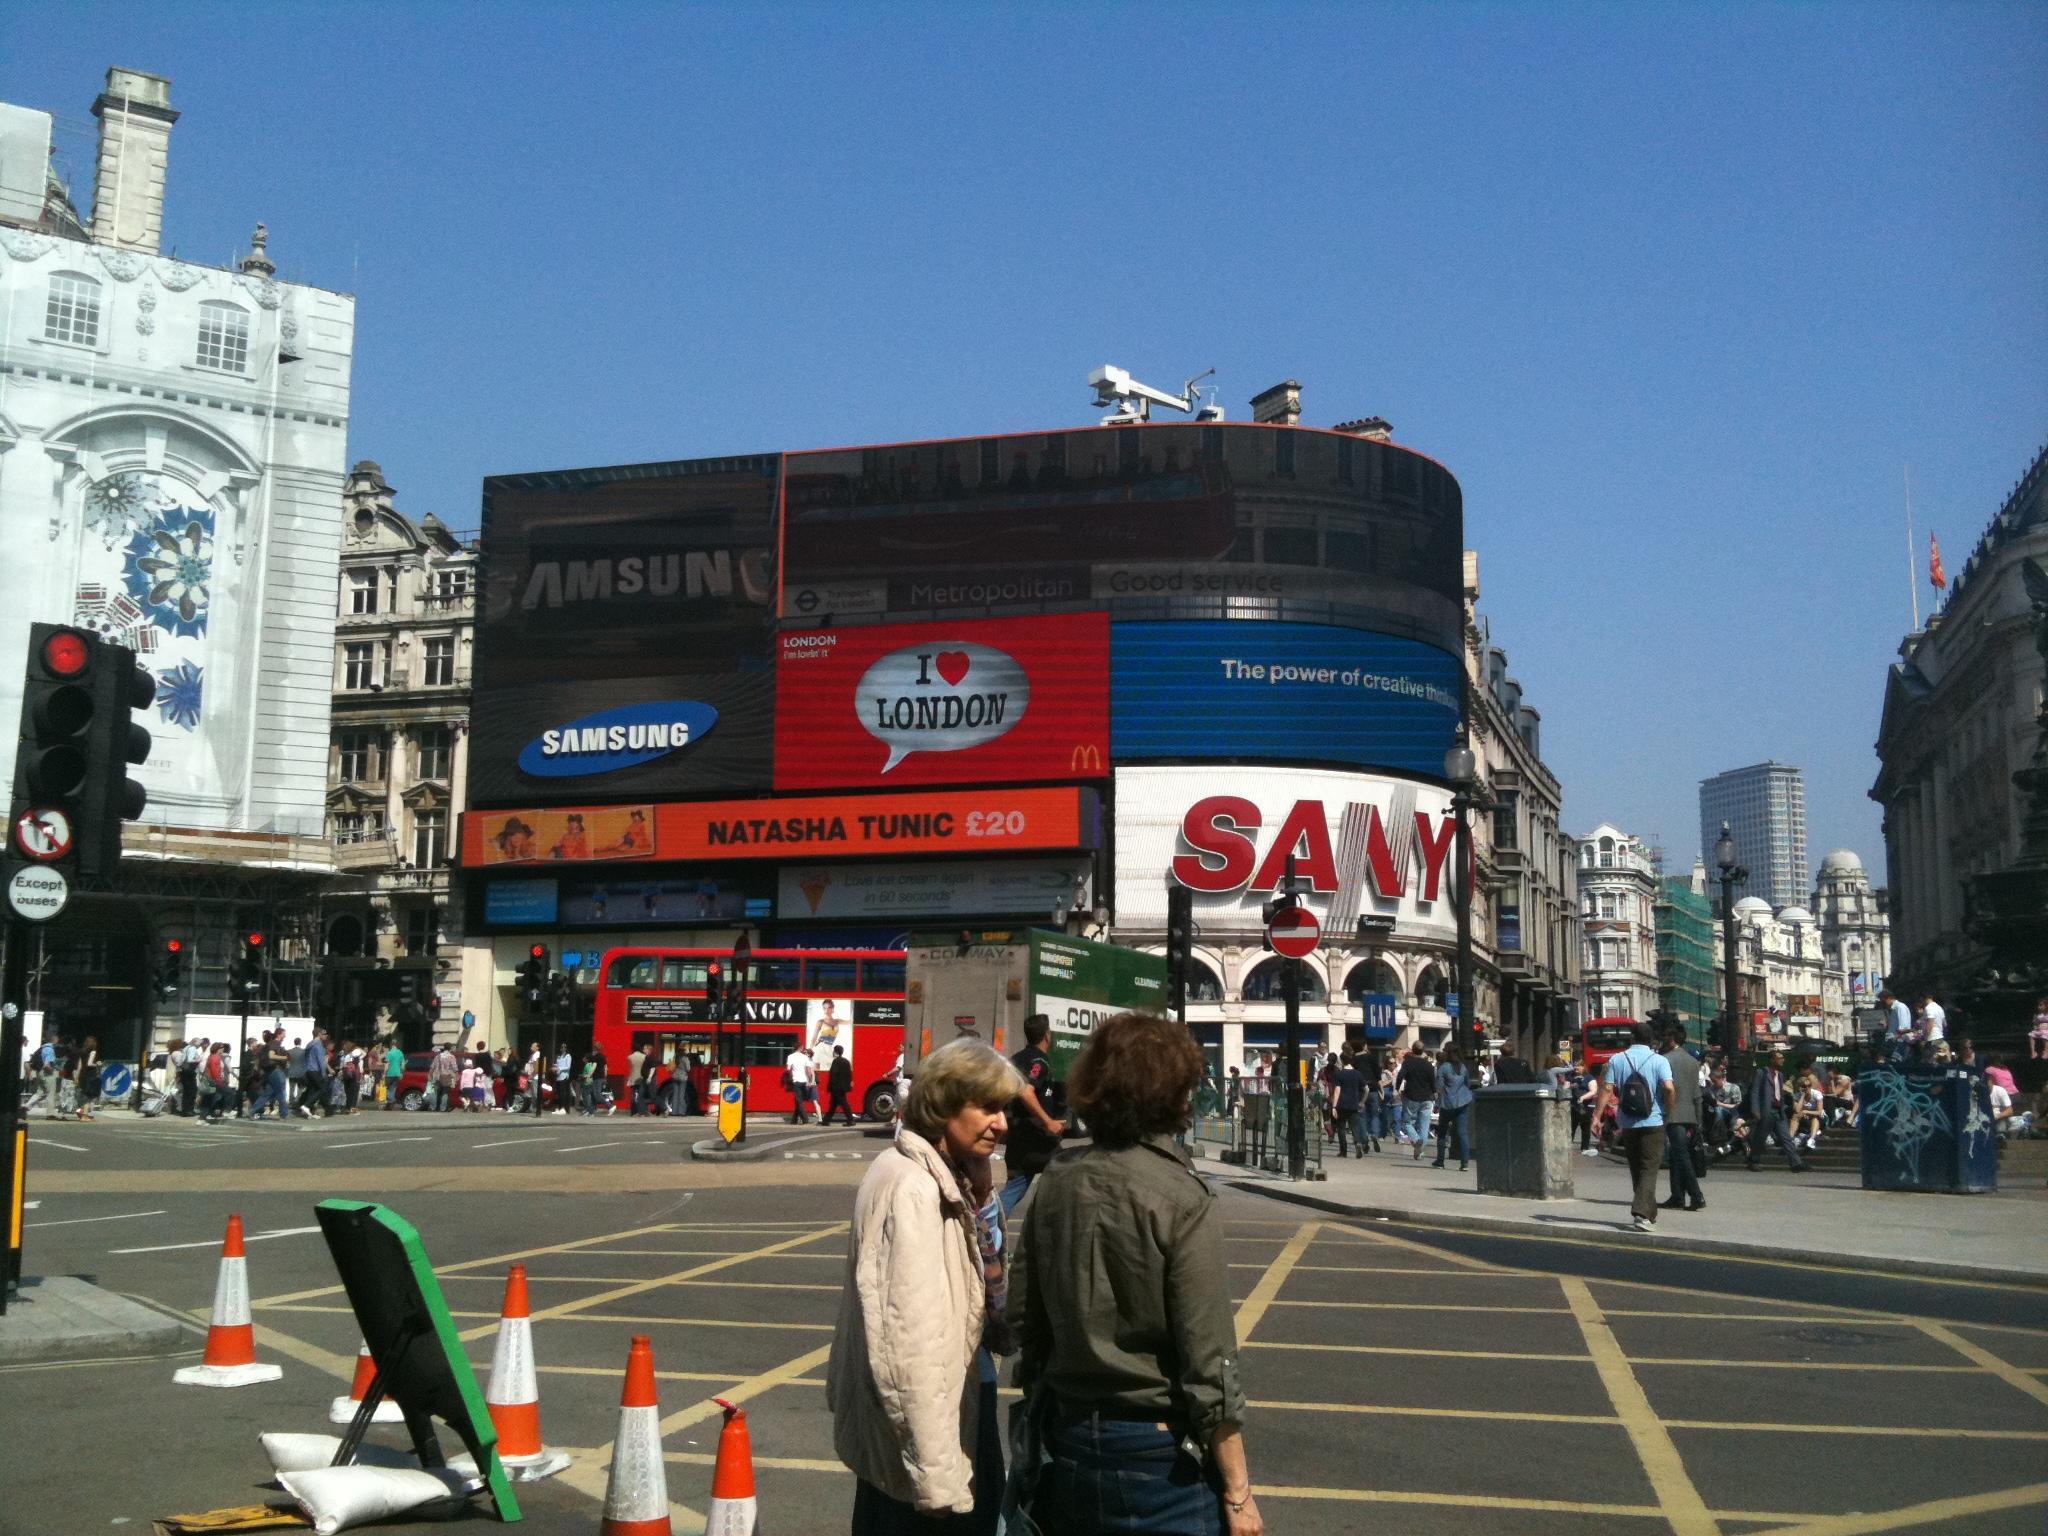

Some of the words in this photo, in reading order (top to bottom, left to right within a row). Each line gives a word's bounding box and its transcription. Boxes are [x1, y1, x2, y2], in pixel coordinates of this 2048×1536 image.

[911, 577, 1073, 605] Metropolitan
[1109, 570, 1182, 593] Good
[1192, 571, 1283, 593] service
[784, 635, 837, 647] LONDON
[915, 654, 932, 685] I
[1221, 659, 1264, 681] The
[1271, 663, 1338, 685] power
[1342, 667, 1361, 686] of
[1363, 673, 1425, 699] creative
[876, 693, 1008, 730] LONDON
[542, 722, 689, 755] SAMSUNG
[708, 817, 847, 845] NATASHA
[858, 812, 955, 840] TUNIC
[966, 810, 1025, 837] £20
[1172, 795, 1474, 907] SANY
[16, 877, 63, 891] Except
[17, 893, 58, 907] buses
[930, 945, 1005, 960] COWAY
[733, 1002, 793, 1021] NGO
[1369, 1004, 1391, 1028] GAP
